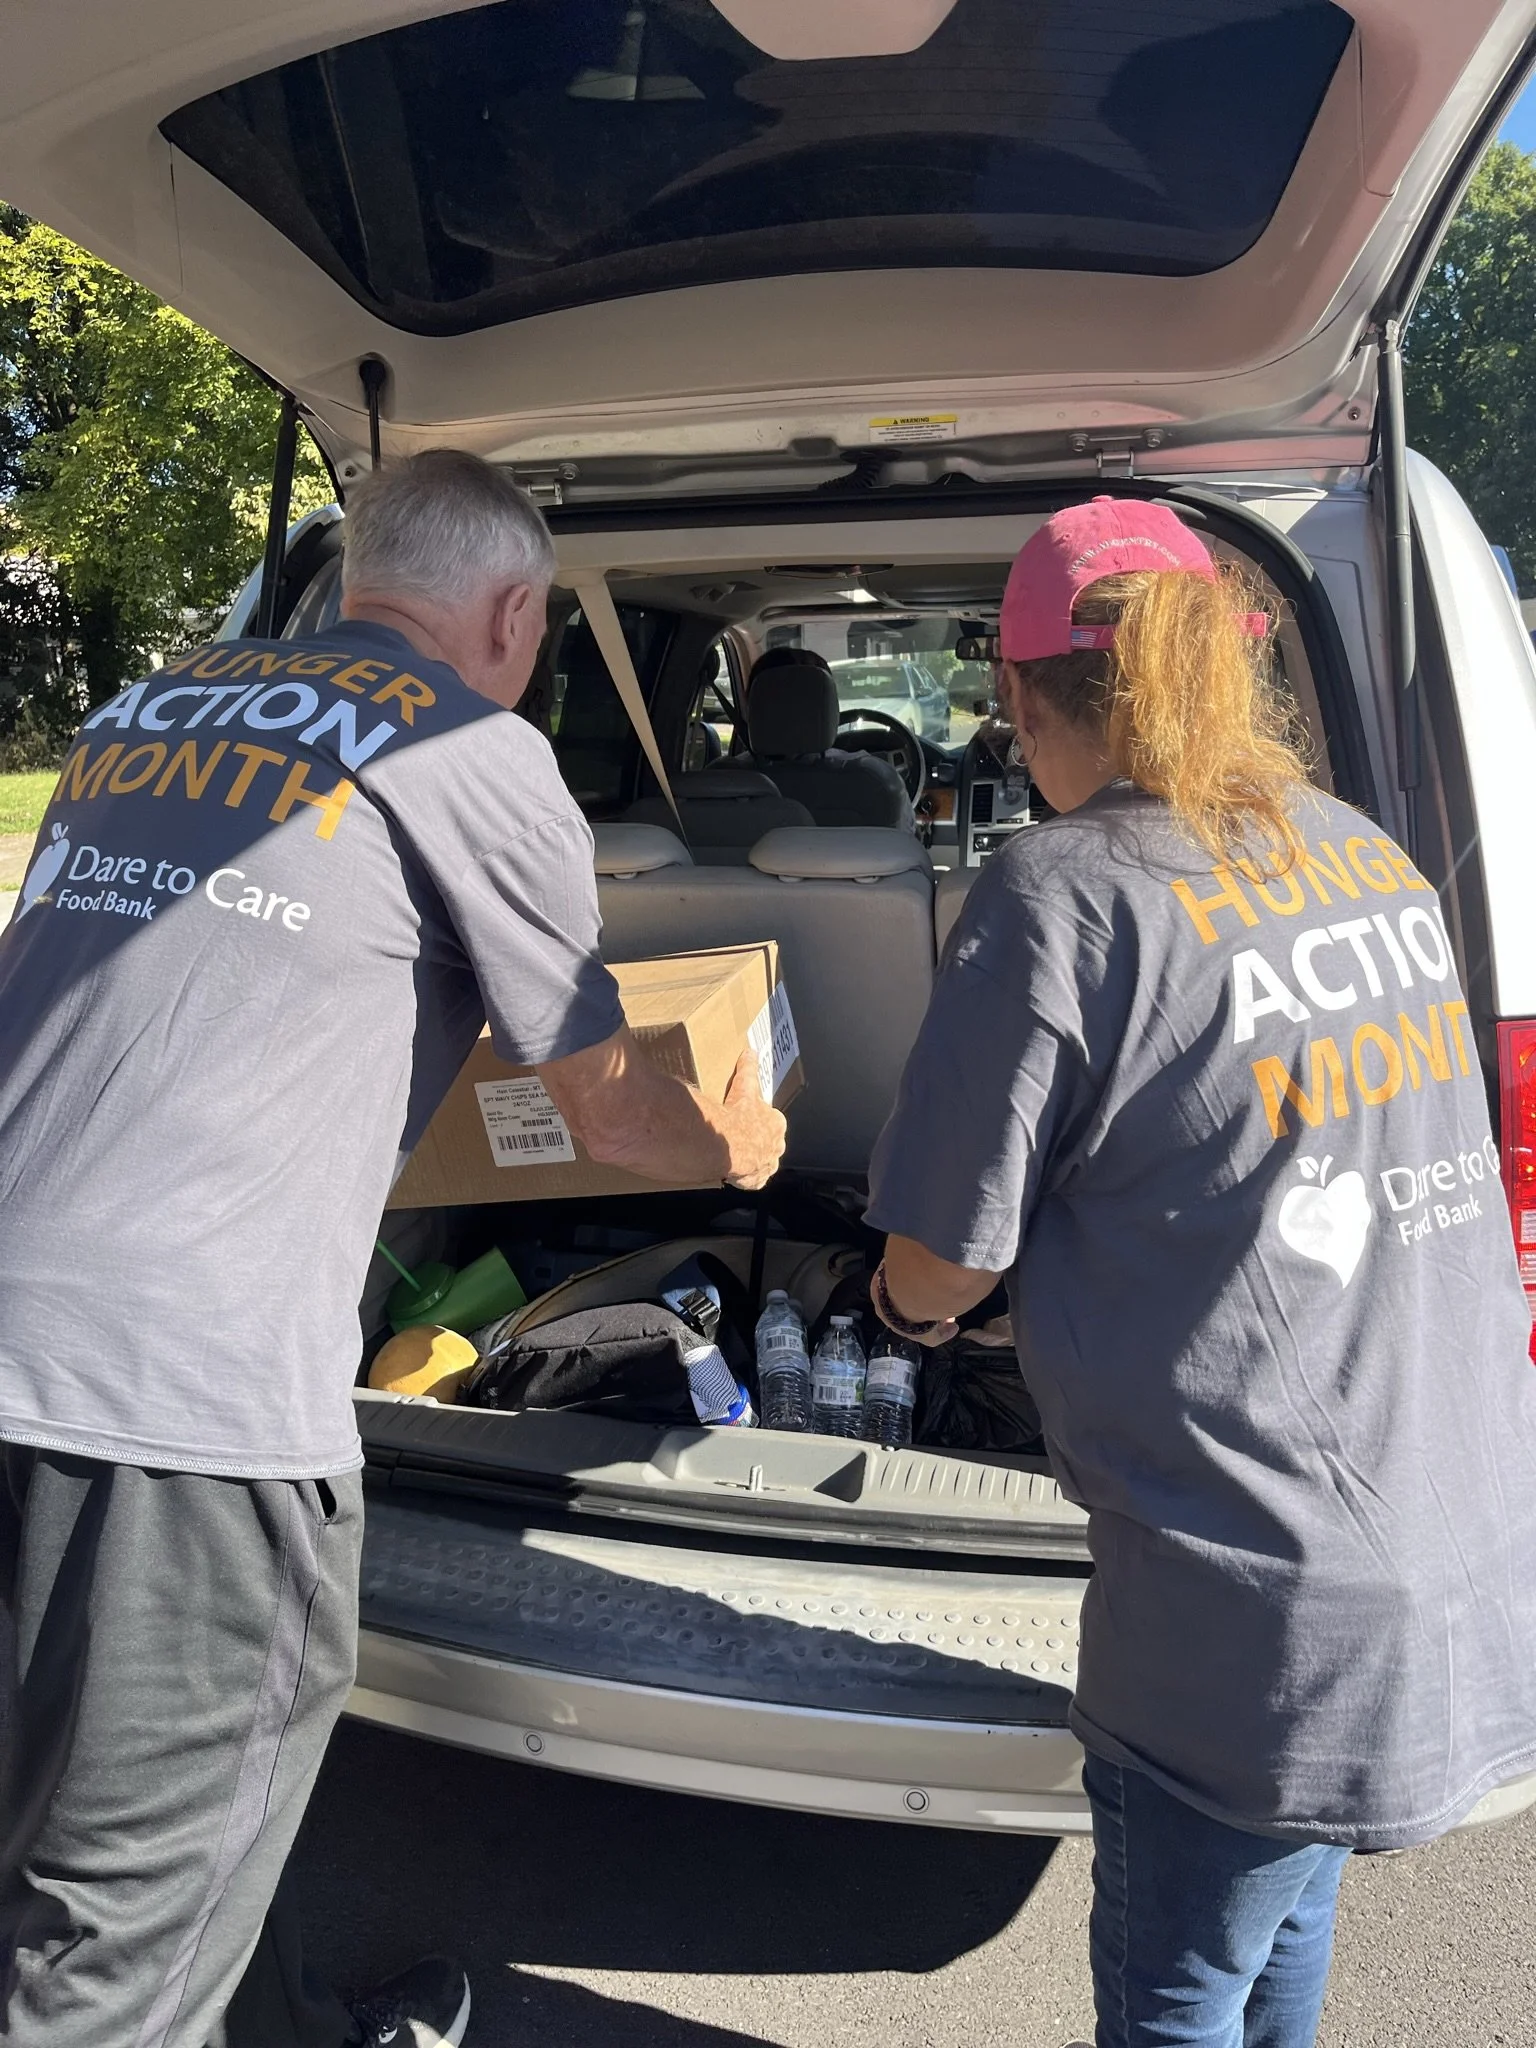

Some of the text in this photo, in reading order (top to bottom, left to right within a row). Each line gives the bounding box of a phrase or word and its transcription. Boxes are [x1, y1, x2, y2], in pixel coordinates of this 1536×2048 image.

[84, 682, 397, 772] ACTION
[54, 741, 356, 841] MONTH
[56, 889, 157, 920] Food Bank
[68, 846, 311, 932] Dare to Care
[1170, 837, 1435, 945] HUNGE
[1233, 906, 1456, 1044] ACTIO
[1251, 1001, 1470, 1140] MONT
[1458, 1151, 1485, 1185] to
[1398, 1193, 1483, 1246] Fod Bank
